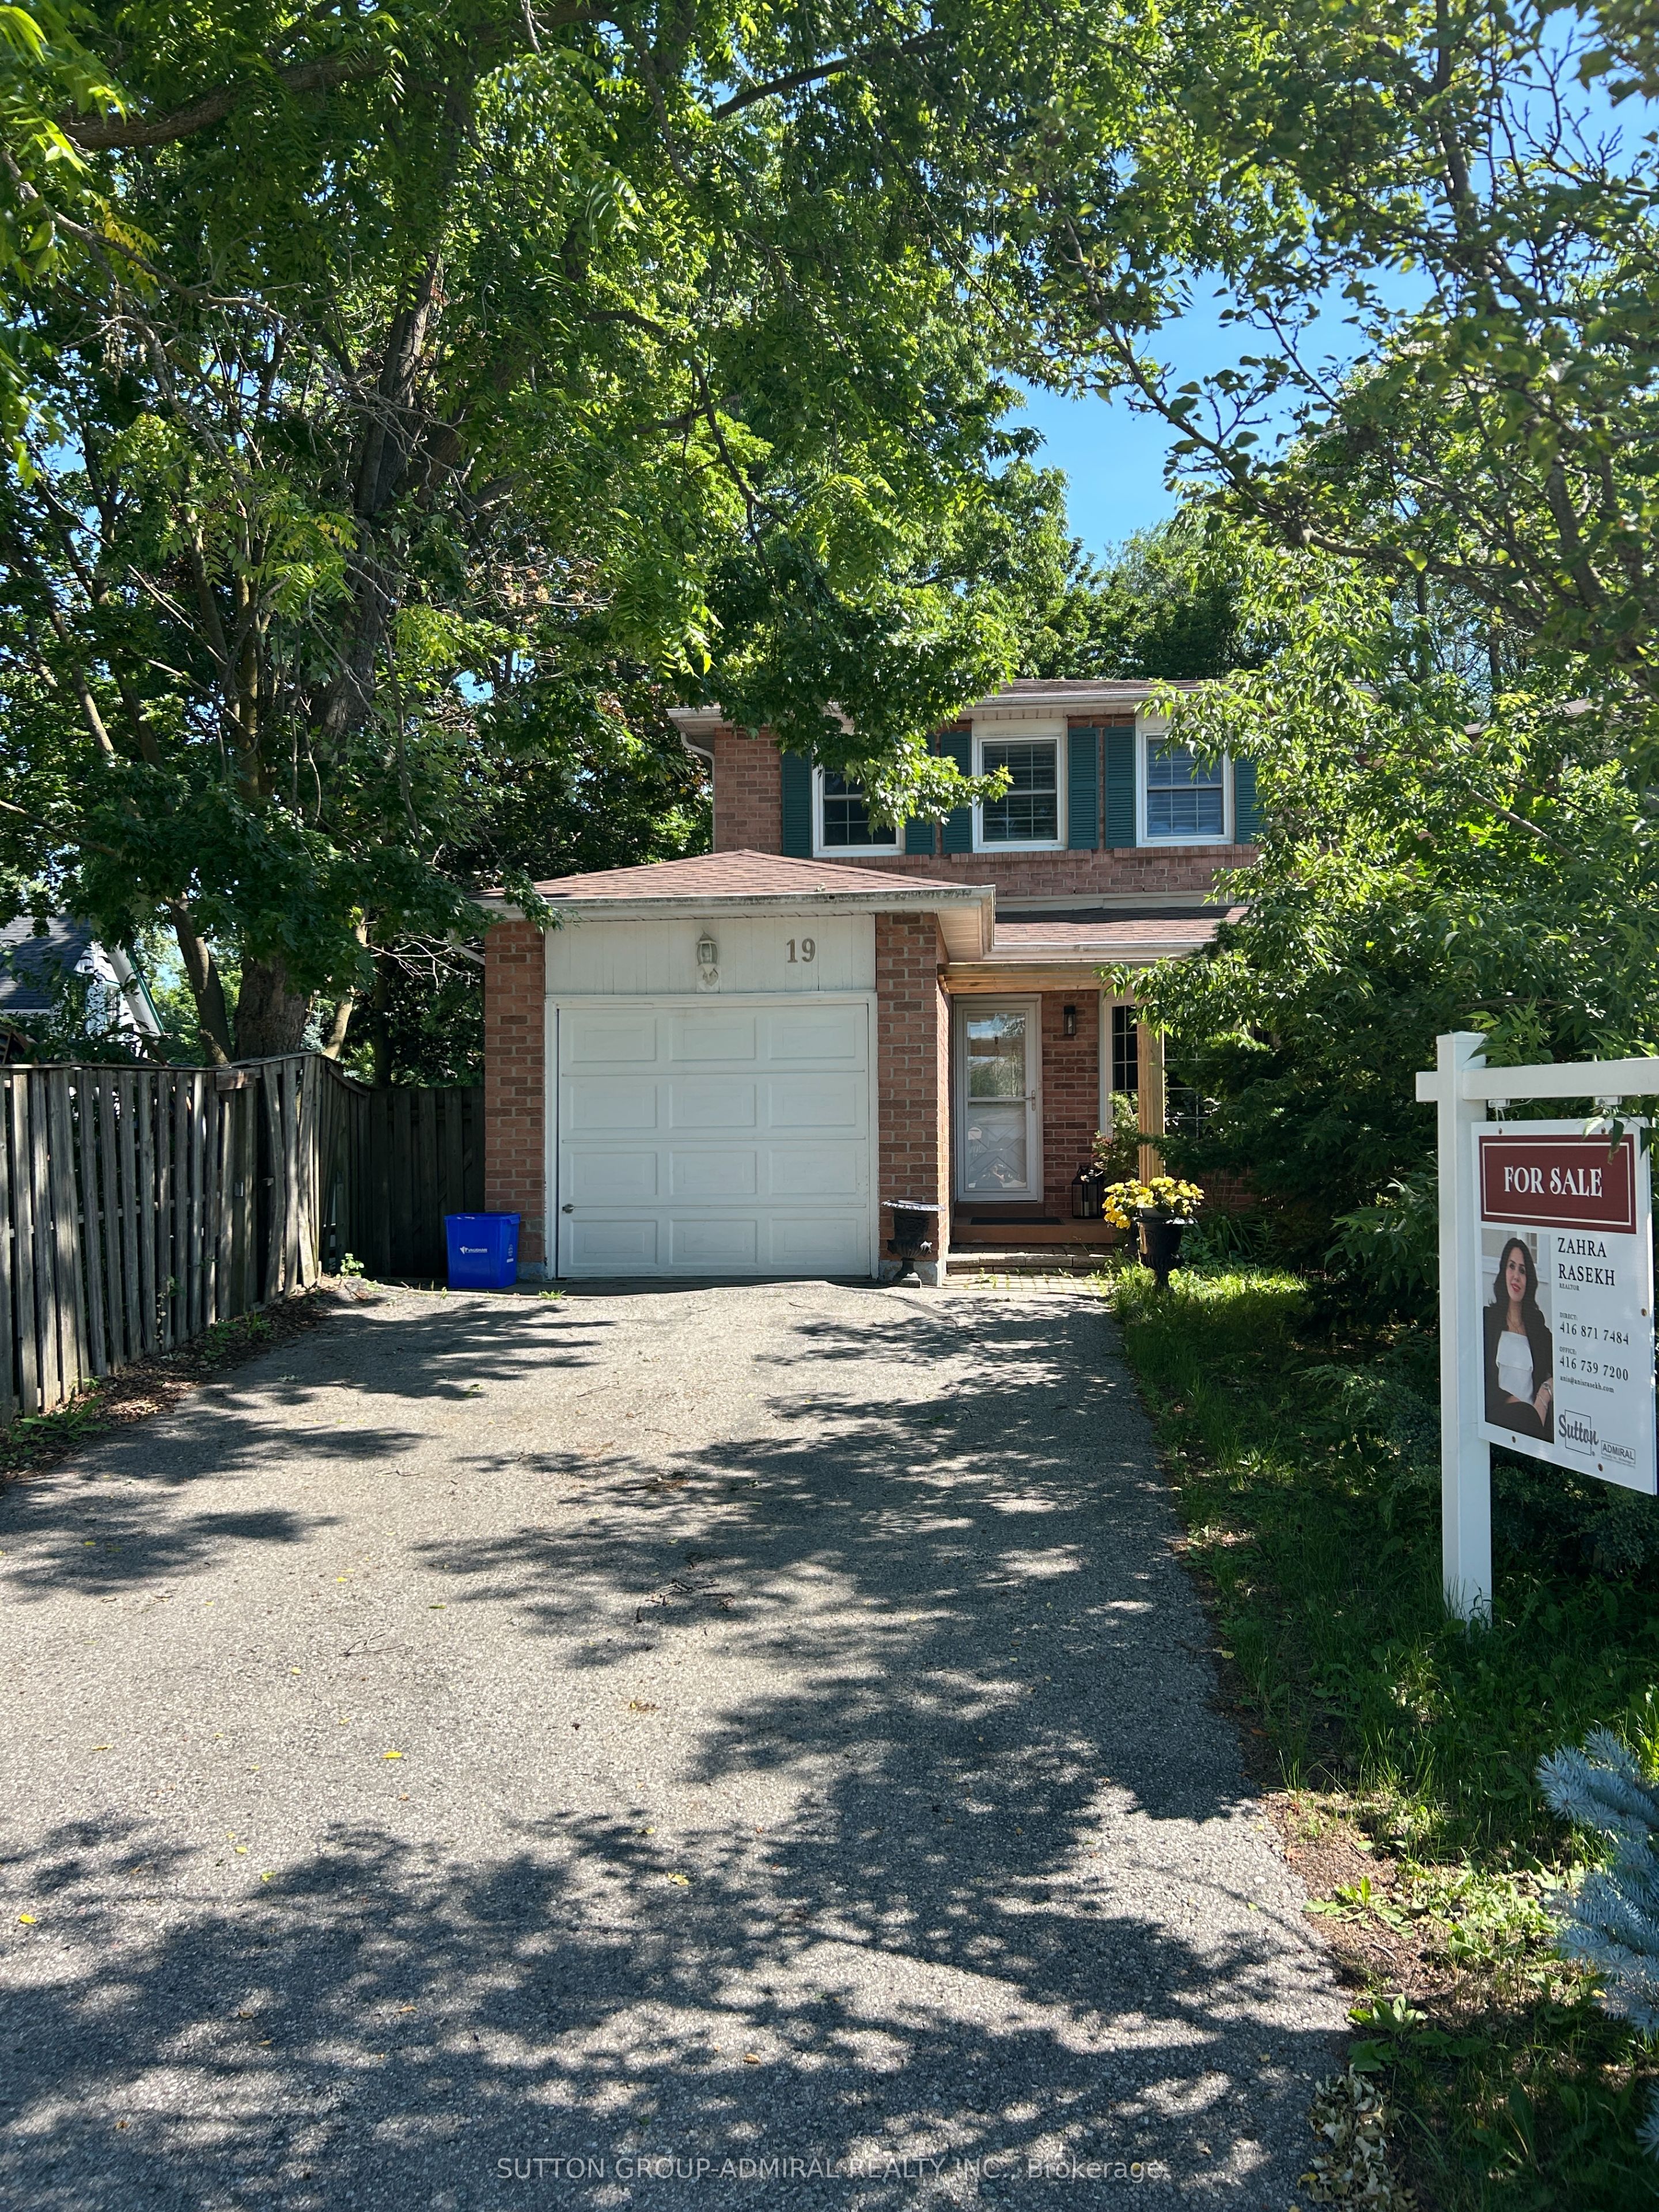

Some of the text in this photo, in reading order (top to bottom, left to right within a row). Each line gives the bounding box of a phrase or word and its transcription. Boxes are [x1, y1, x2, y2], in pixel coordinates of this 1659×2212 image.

[786, 938, 816, 963] 19
[1503, 1166, 1603, 1198] FOR SALE
[1558, 1237, 1607, 1257] ZAHRA
[1558, 1263, 1615, 1286] RASEKH
[1559, 1283, 1580, 1291] REALTOR
[1559, 1321, 1629, 1345] 416 871 7484
[1559, 1355, 1628, 1381] 416 739 7200
[1560, 1376, 1614, 1393] anis@anisrasekh.com
[1558, 1414, 1599, 1445] Sutton
[1602, 1443, 1635, 1460] ADMIRAL
